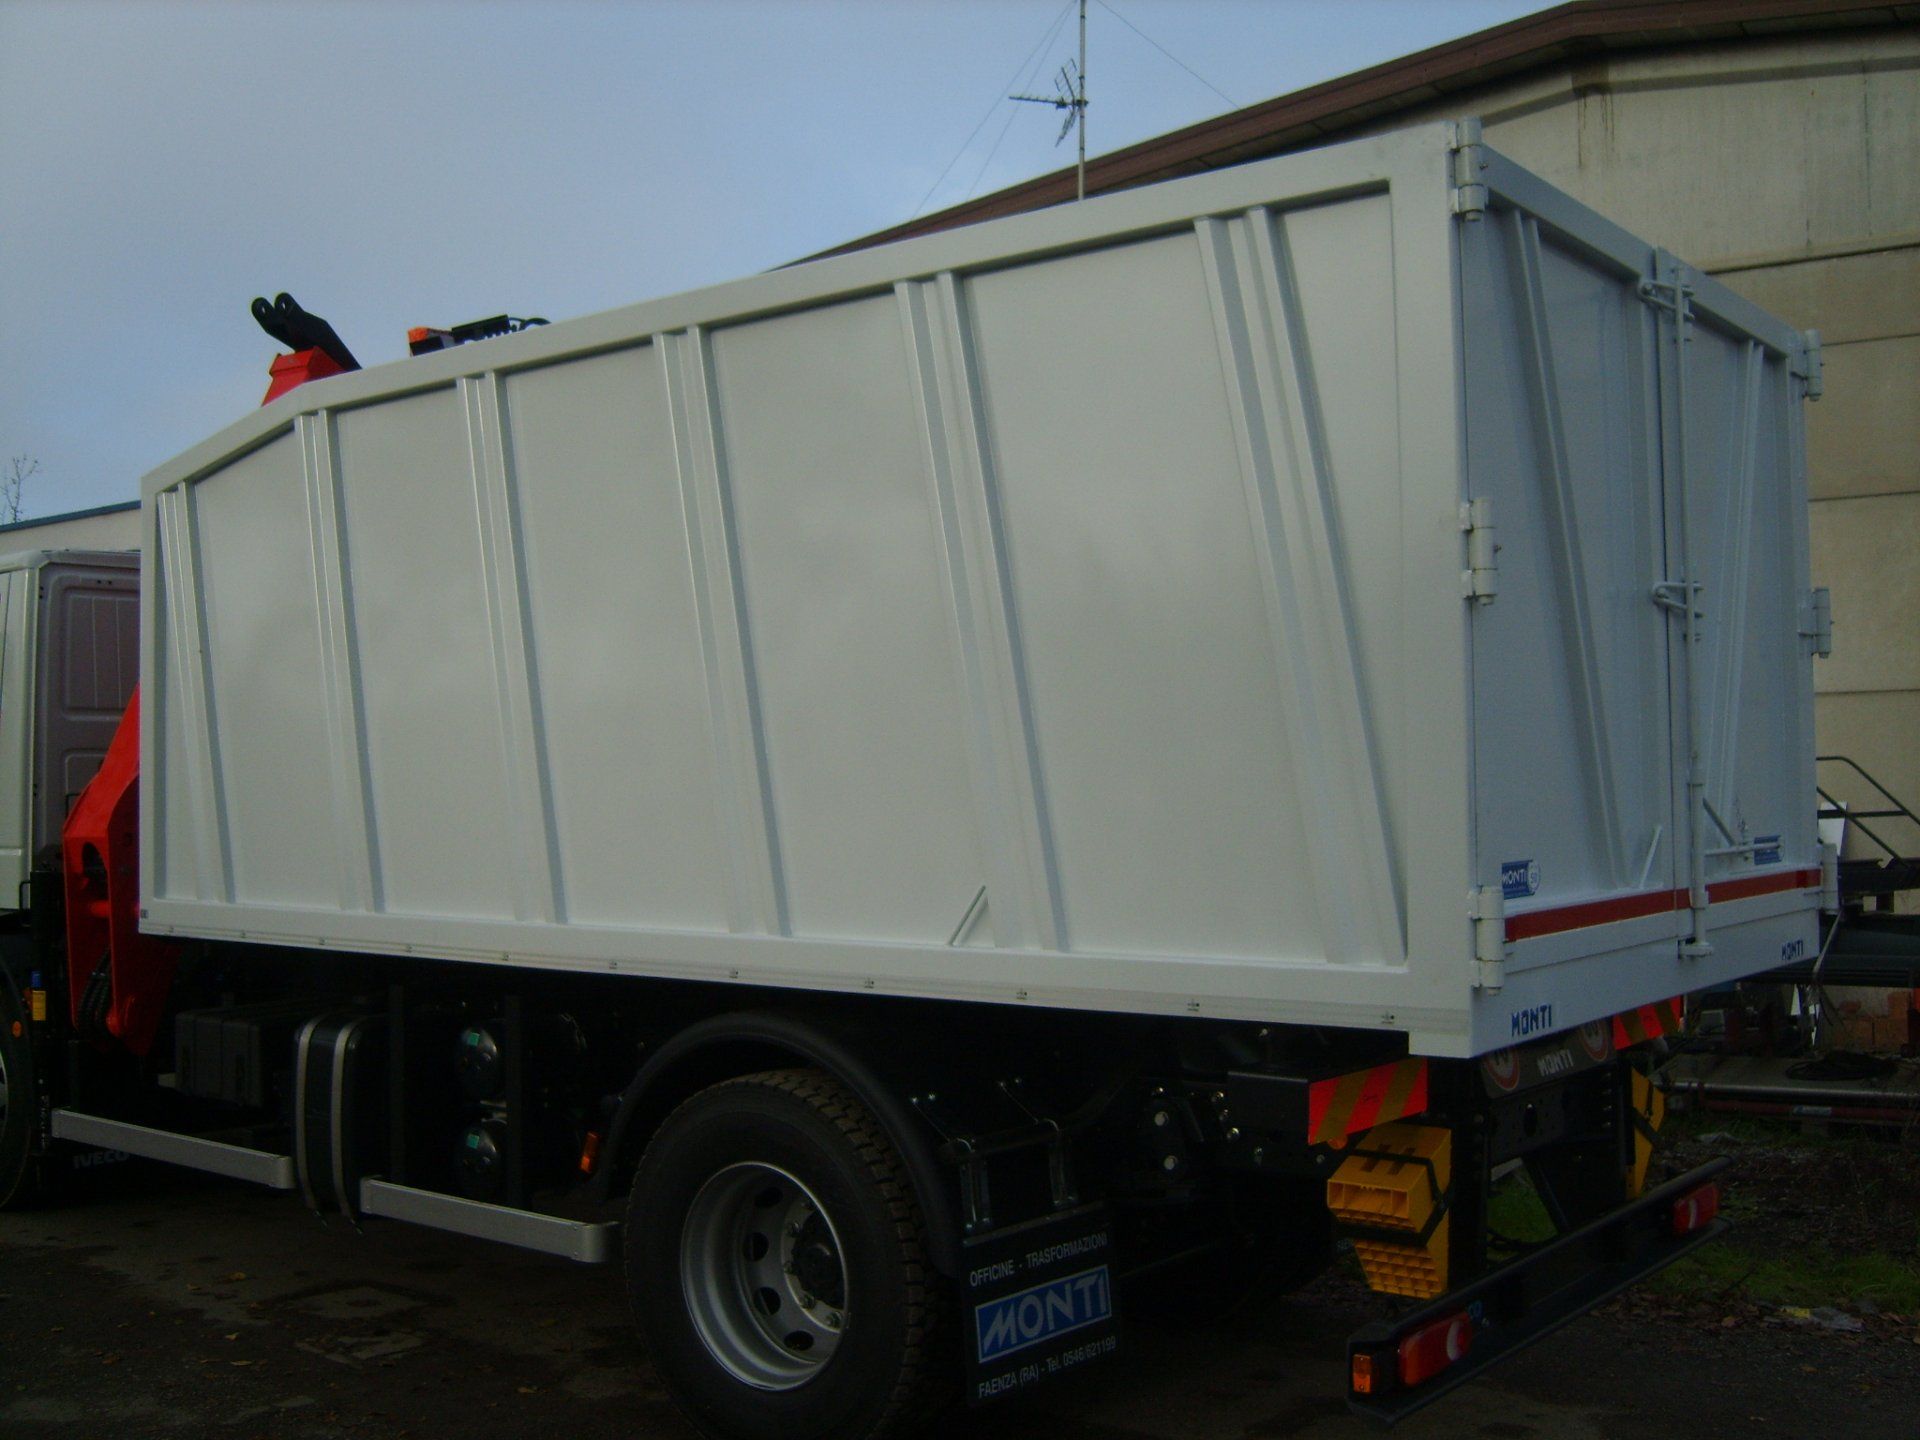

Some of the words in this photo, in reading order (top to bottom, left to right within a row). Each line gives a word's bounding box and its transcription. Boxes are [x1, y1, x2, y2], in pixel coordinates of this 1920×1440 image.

[1511, 1004, 1552, 1037] MONTI
[1537, 1048, 1574, 1077] MONTI
[969, 1259, 1015, 1287] OFFICINE
[1025, 1232, 1108, 1269] TRASFORMAZIONI
[983, 1273, 1107, 1353] MONTI
[978, 1372, 1017, 1398] FAENZA
[1019, 1363, 1039, 1387] (RA)
